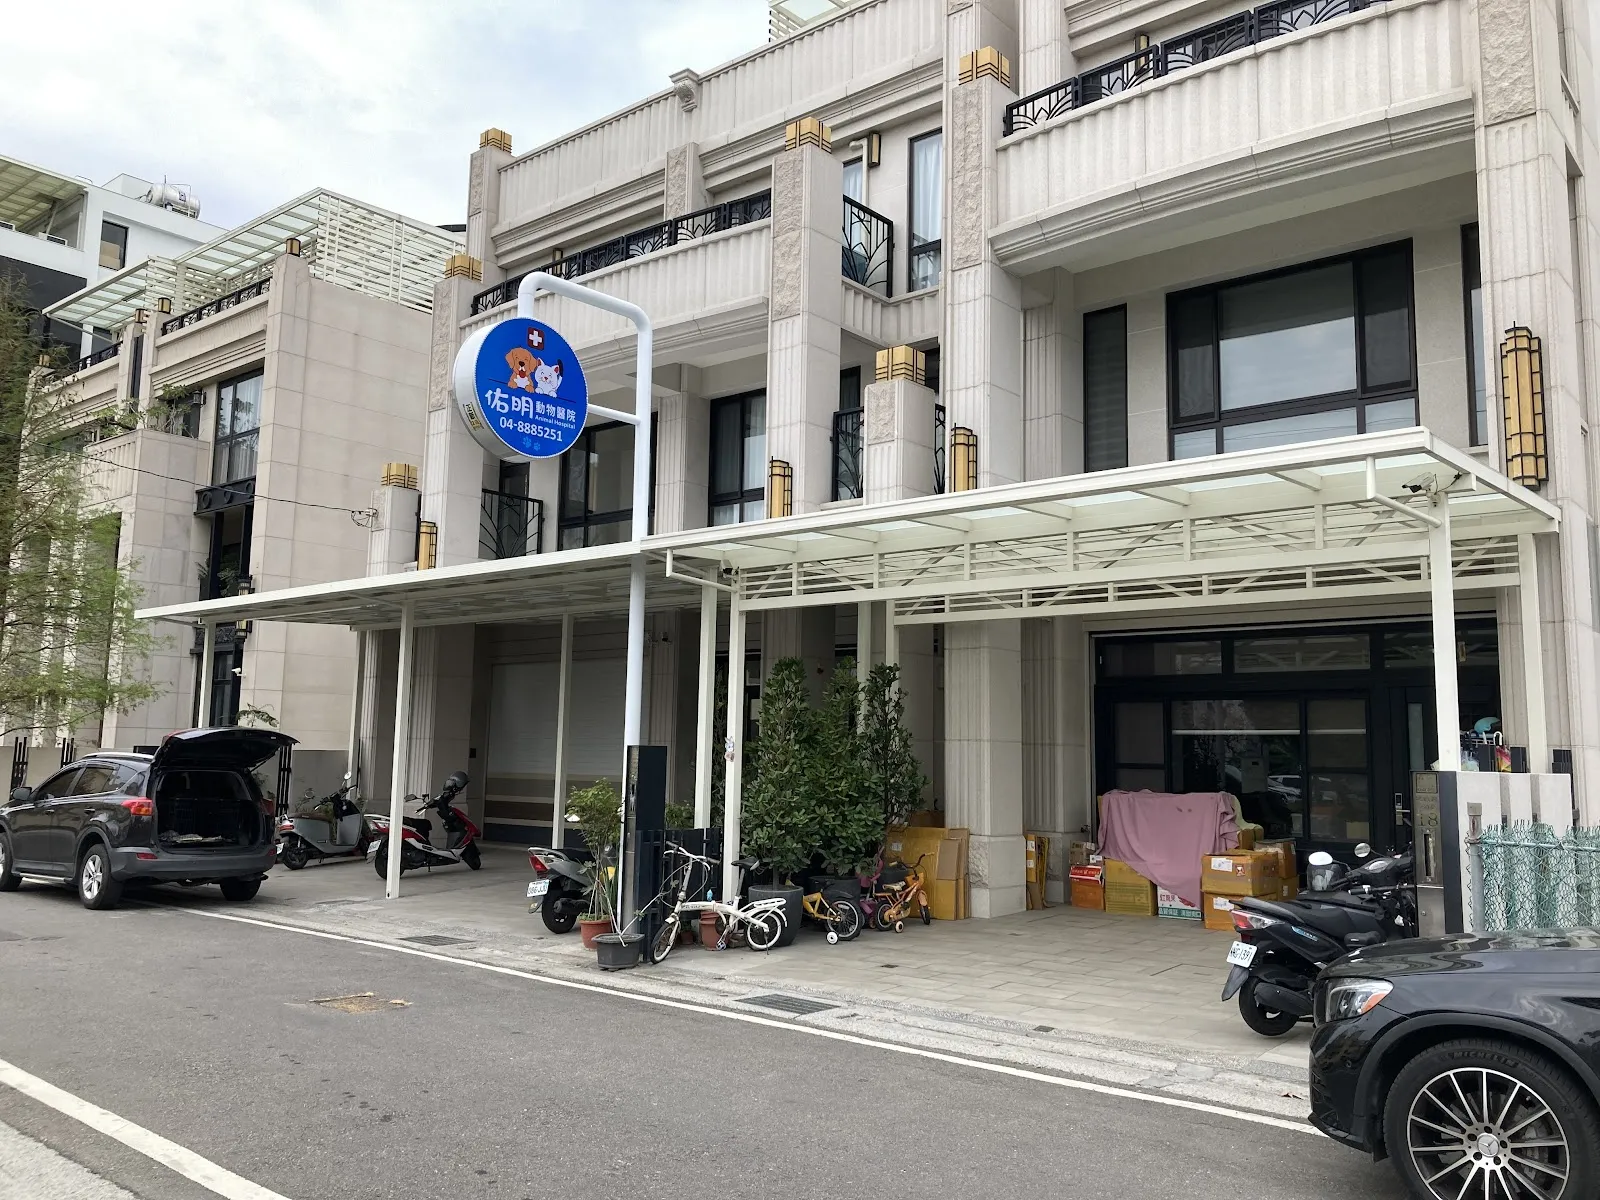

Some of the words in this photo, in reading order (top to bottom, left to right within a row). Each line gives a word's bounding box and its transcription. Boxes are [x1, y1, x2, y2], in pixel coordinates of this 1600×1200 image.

[485, 388, 533, 419] 佑明
[535, 401, 576, 423] 動物醫院
[500, 417, 563, 442] 04-8885251
[535, 415, 554, 424] Animal
[554, 420, 576, 429] Hospital
[1452, 1051, 1517, 1068] MICHELIN
